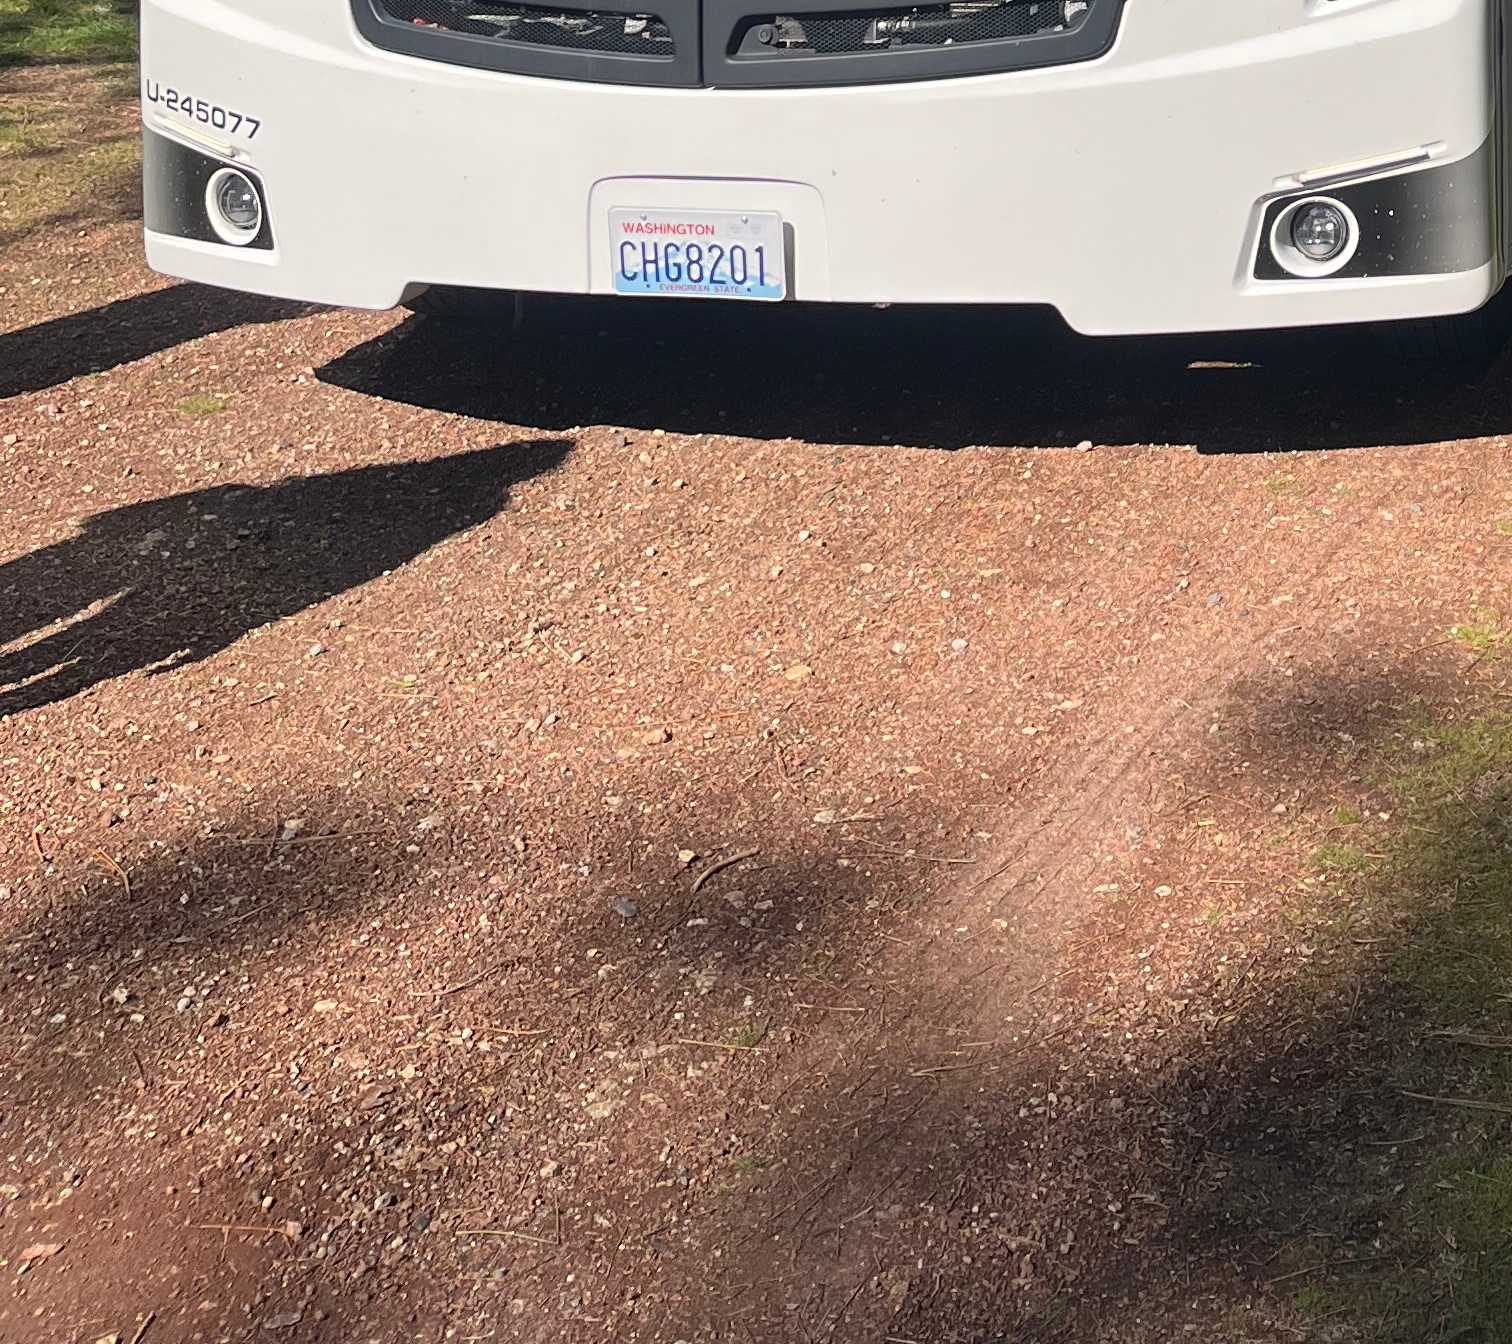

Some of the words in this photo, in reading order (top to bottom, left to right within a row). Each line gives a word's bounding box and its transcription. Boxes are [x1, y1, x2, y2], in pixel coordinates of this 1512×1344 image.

[146, 78, 261, 140] U-245077
[622, 222, 716, 236] WASHINGTON
[619, 240, 766, 286] CHG8201
[659, 283, 710, 293] EVERGREEN
[714, 285, 740, 294] STATE
